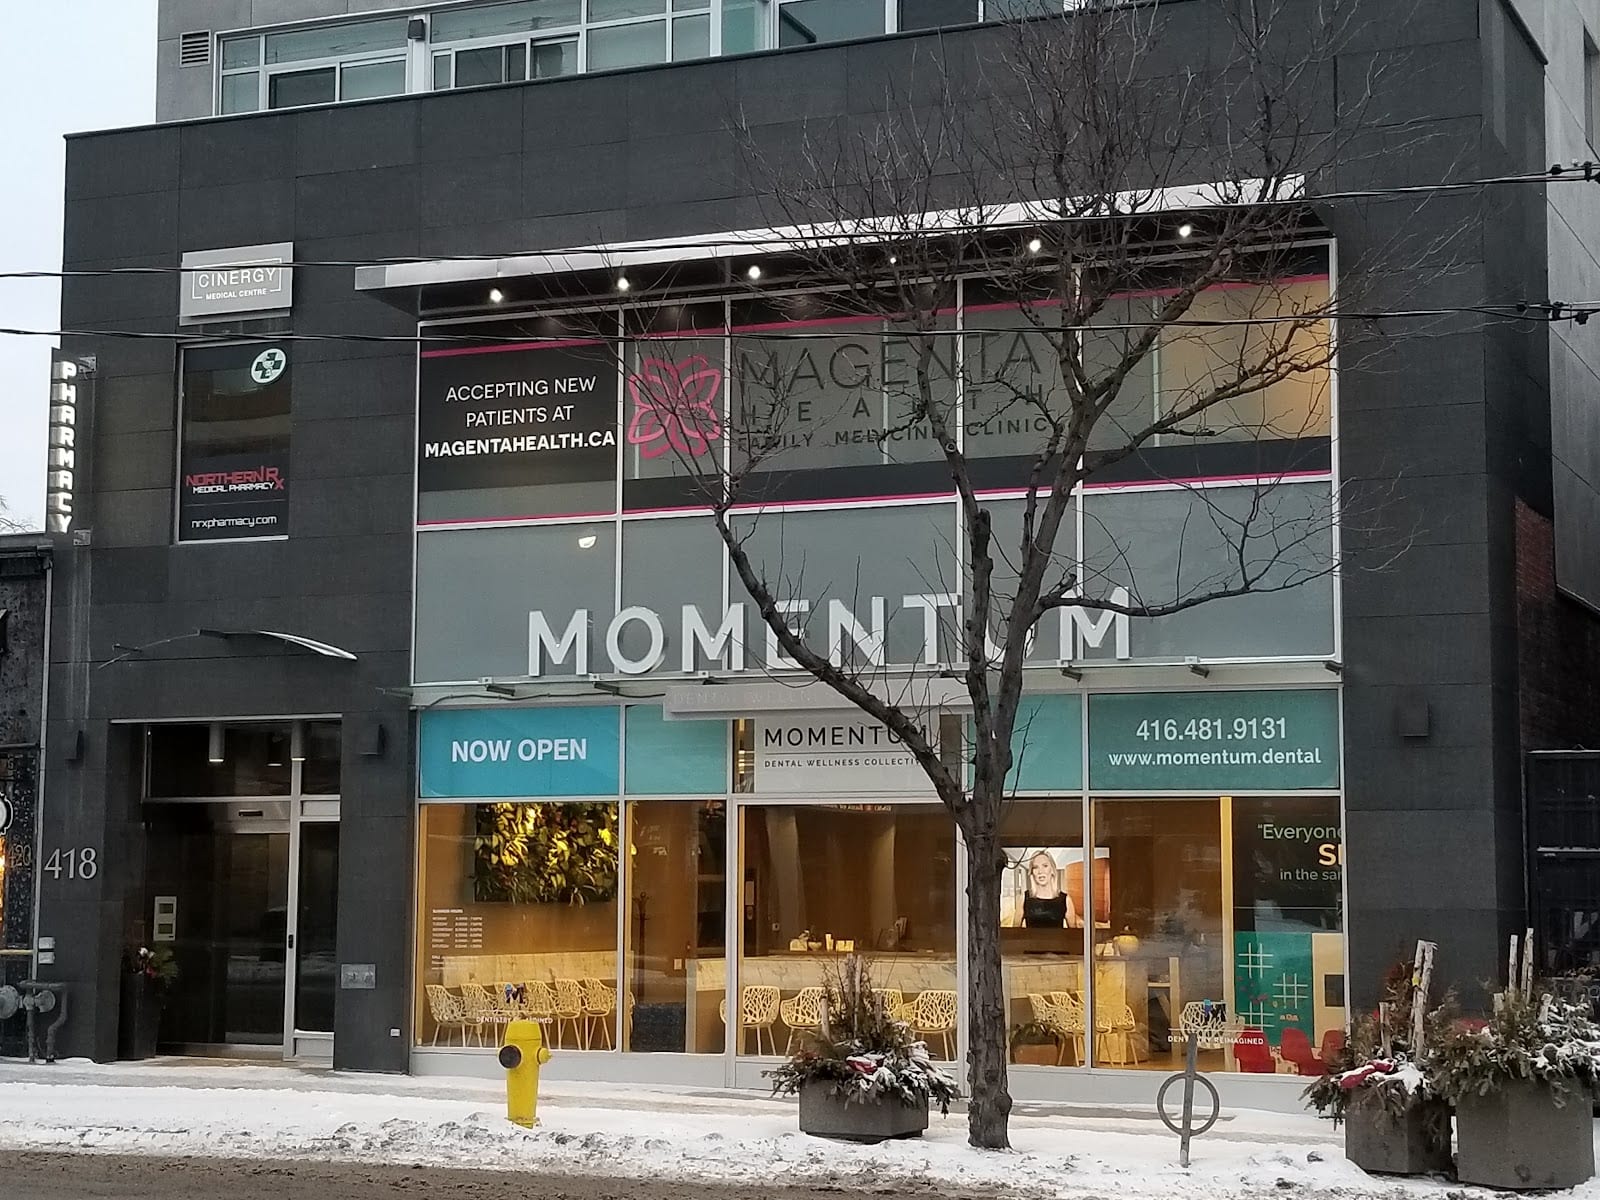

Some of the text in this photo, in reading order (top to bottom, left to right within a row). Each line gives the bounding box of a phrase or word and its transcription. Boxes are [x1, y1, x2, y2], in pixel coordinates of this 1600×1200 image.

[198, 268, 276, 288] CINERGY
[206, 288, 267, 300] MEDICAL CENTRE
[445, 376, 597, 402] ACCEPTING NEW
[466, 405, 574, 427] PATIENTS AT
[425, 431, 616, 458] MAGENTAHEALTH.CA
[738, 417, 1047, 451] FAILY MEDICIN CLINIC
[55, 361, 77, 533] PHARMACY
[192, 482, 275, 494] MEDICAL PHARMACY
[191, 516, 277, 529] nrxpharmacy.com
[764, 725, 927, 746] MOMENTU
[1136, 717, 1287, 741] 416.481.9131
[451, 738, 587, 762] NOW OPEN
[1108, 748, 1322, 766] www.momentum.dental
[764, 758, 921, 768] DENTAL WELLNESS COLLECTIV
[44, 848, 97, 879] 418
[1280, 868, 1291, 880] in
[1296, 868, 1318, 880] the
[1167, 1035, 1211, 1044] DENTTRY
